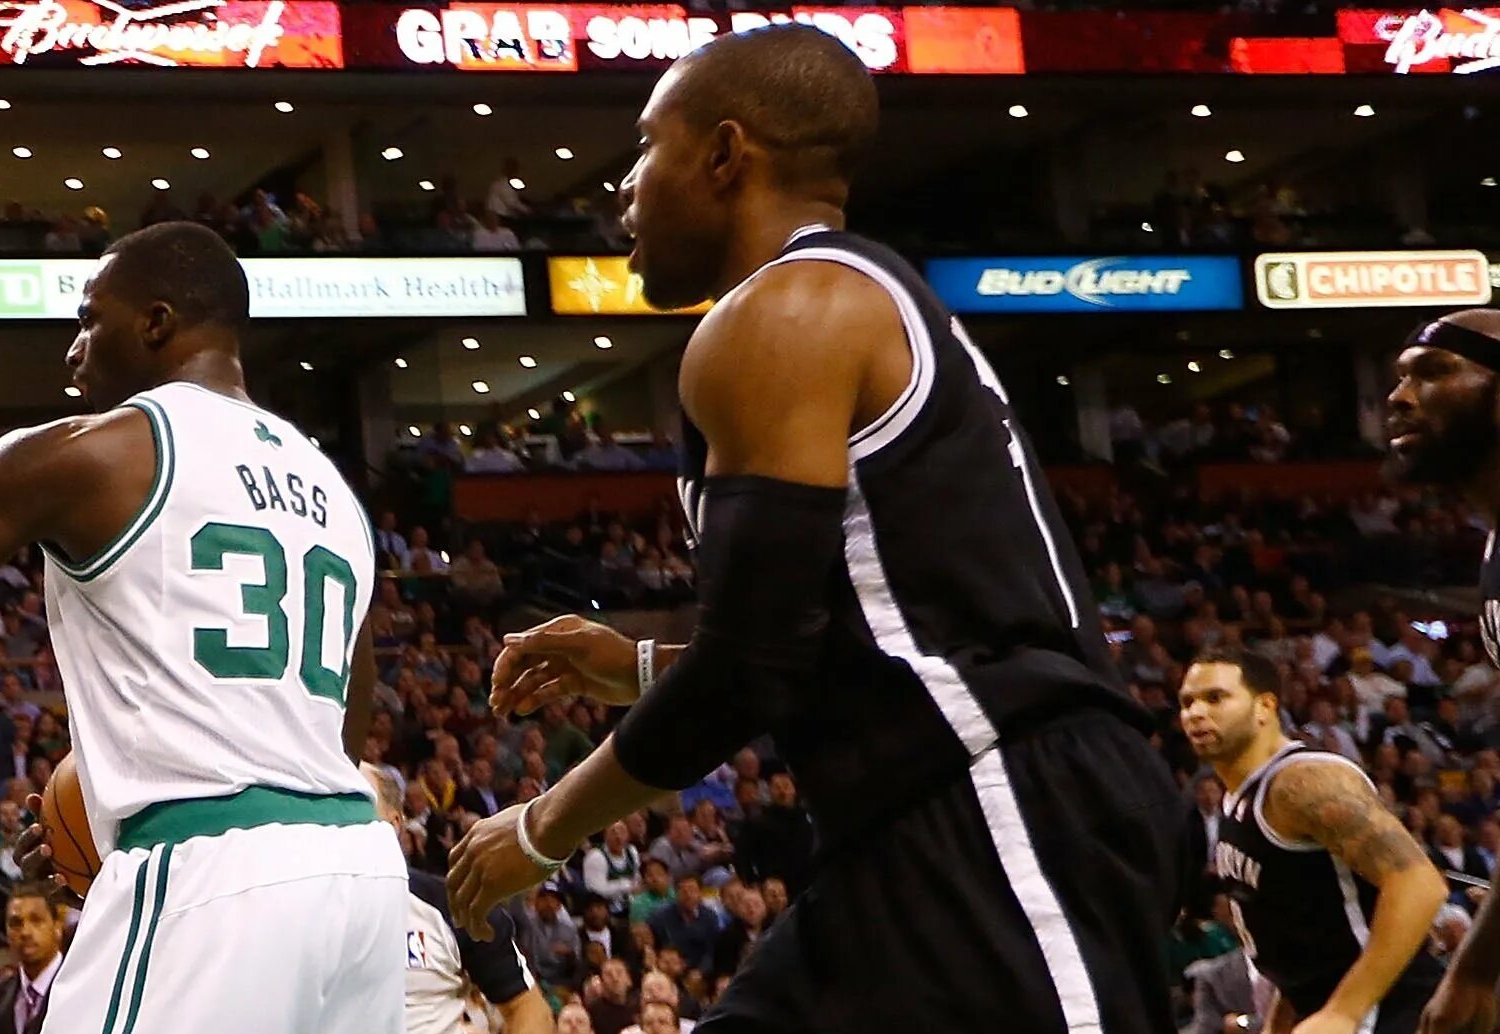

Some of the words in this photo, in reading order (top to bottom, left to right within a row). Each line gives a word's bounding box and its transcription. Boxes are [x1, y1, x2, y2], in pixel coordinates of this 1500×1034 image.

[396, 10, 570, 64] GRAB
[254, 276, 391, 300] Hallmark
[403, 276, 499, 300] Health
[976, 268, 1066, 296] BUD
[1077, 268, 1192, 297] LIGHT
[1308, 262, 1478, 294] CHIPOTLE
[235, 463, 327, 529] BASS
[189, 520, 358, 710] 30
